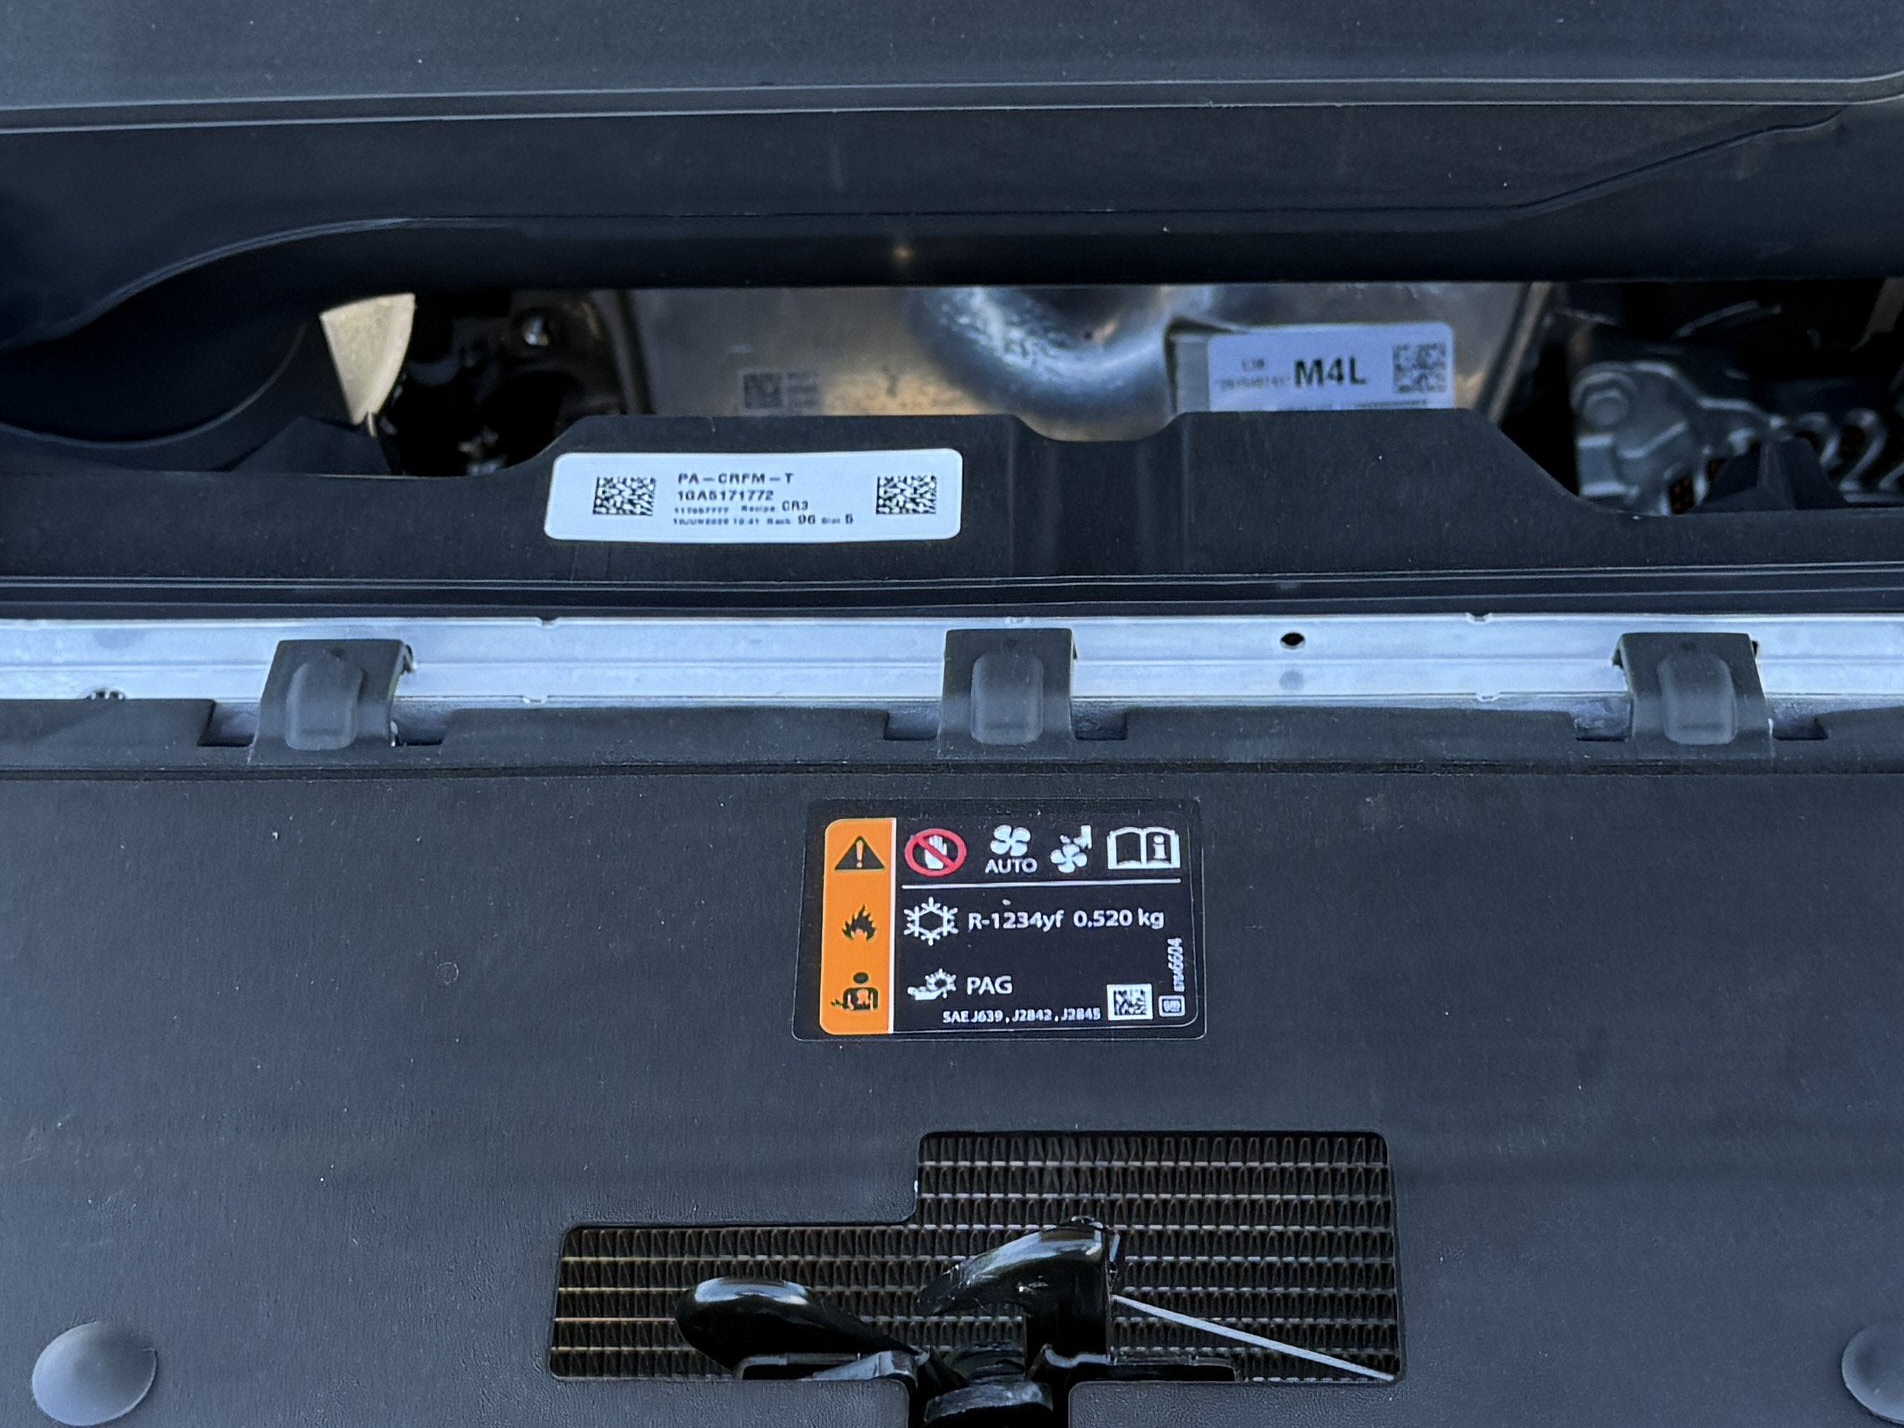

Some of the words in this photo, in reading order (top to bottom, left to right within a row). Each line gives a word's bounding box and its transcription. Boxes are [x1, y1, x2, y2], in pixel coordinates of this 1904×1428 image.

[1293, 355, 1367, 388] M4L
[985, 858, 1038, 874] AUTO
[968, 910, 1064, 932] R-1234yf
[1073, 910, 1133, 928] 0.520
[1138, 908, 1165, 929] kg
[966, 975, 1013, 995] PAG
